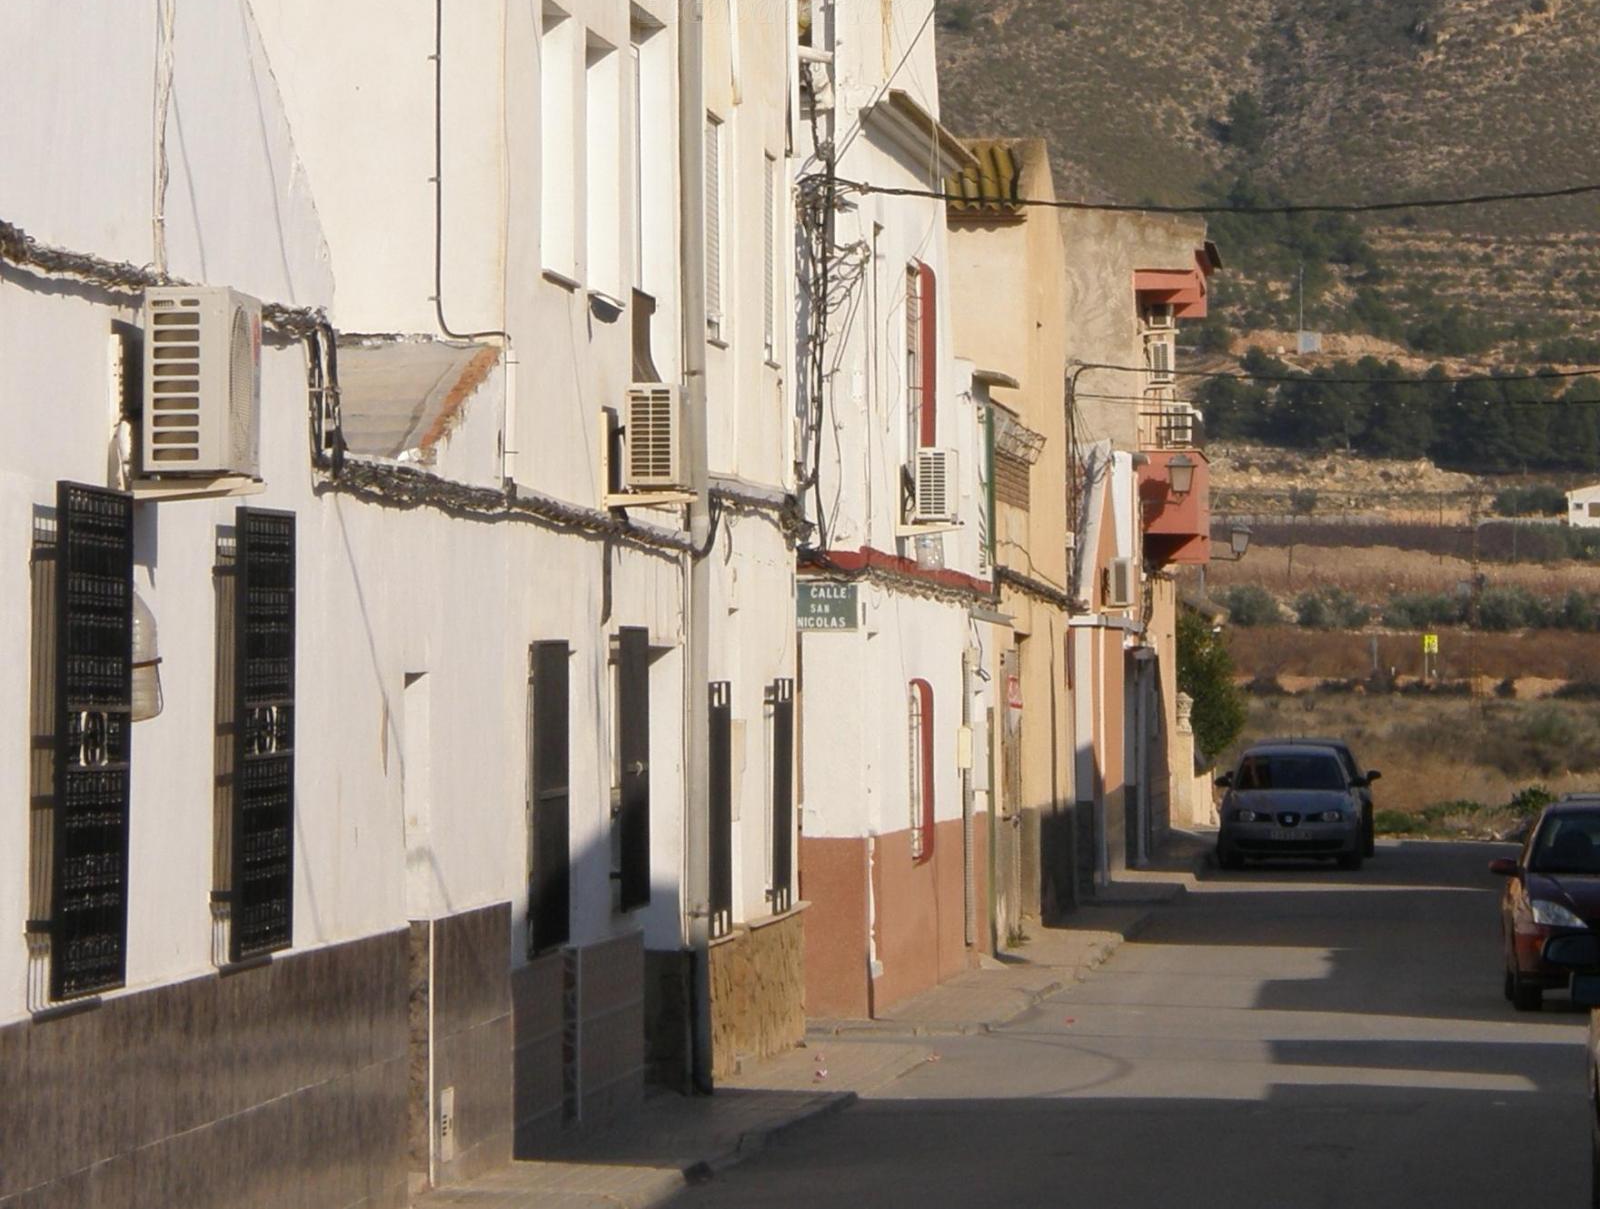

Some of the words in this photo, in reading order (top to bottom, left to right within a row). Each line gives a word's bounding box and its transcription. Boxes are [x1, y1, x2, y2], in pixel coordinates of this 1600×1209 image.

[810, 587, 847, 599] CALLE
[810, 603, 830, 613] SAN
[797, 616, 846, 628] NICOLAS
